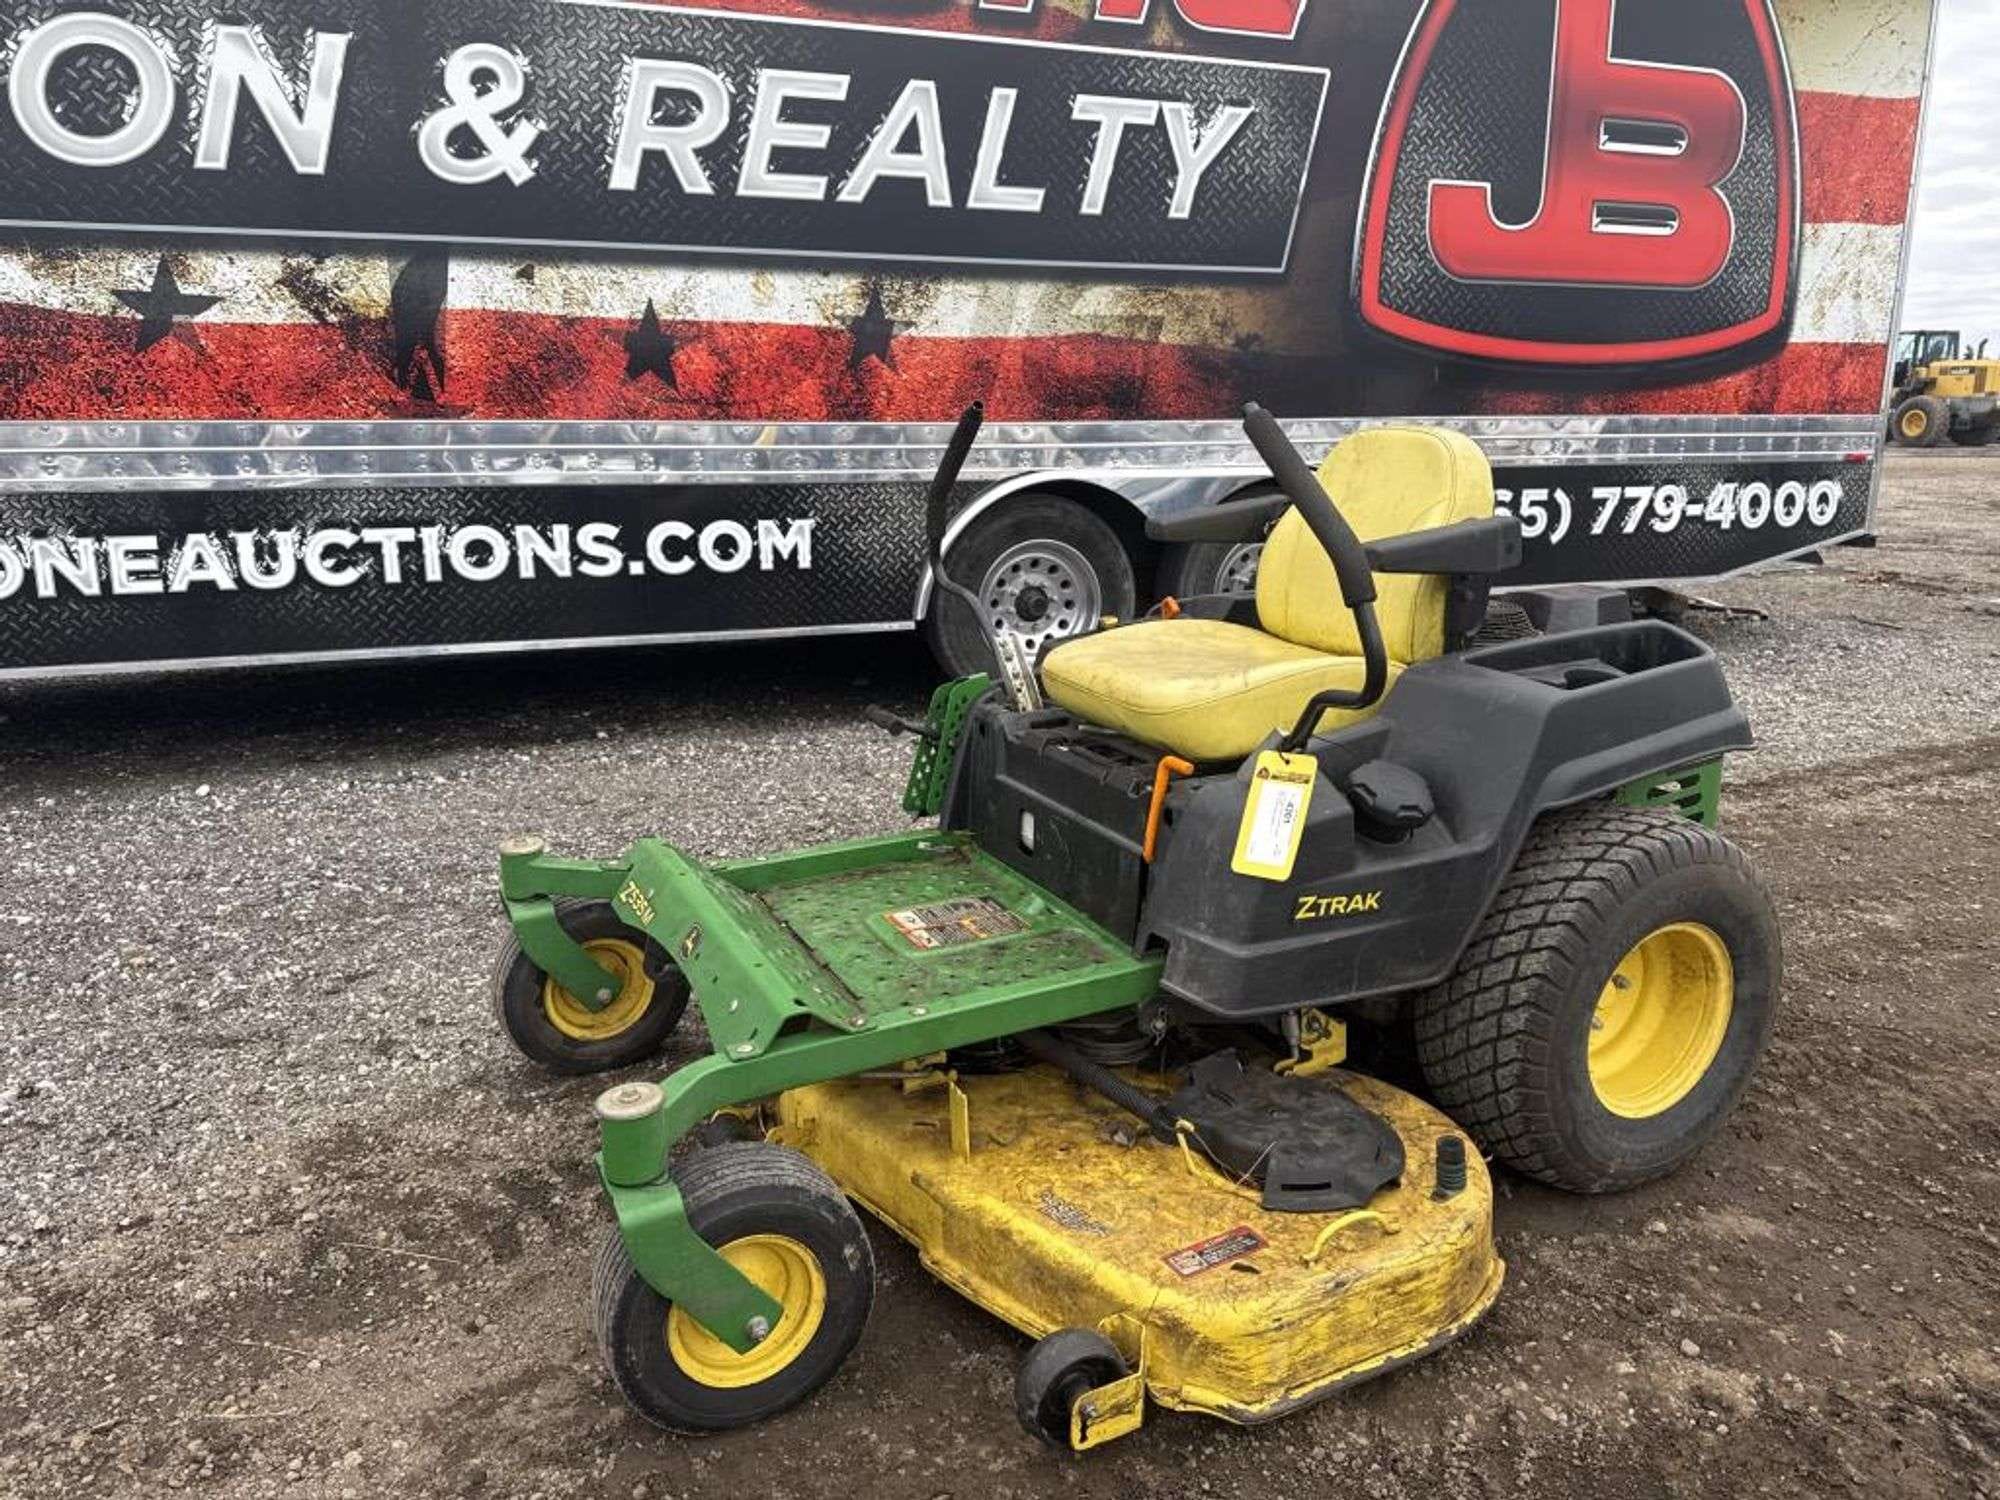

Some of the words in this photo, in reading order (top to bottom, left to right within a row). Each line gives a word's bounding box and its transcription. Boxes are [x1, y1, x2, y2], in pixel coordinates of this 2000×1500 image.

[8, 11, 351, 175] ON
[416, 42, 546, 187] &
[607, 57, 1255, 220] REALTY
[1590, 480, 1843, 534] 779-4000
[1294, 890, 1383, 920] ZTRAK
